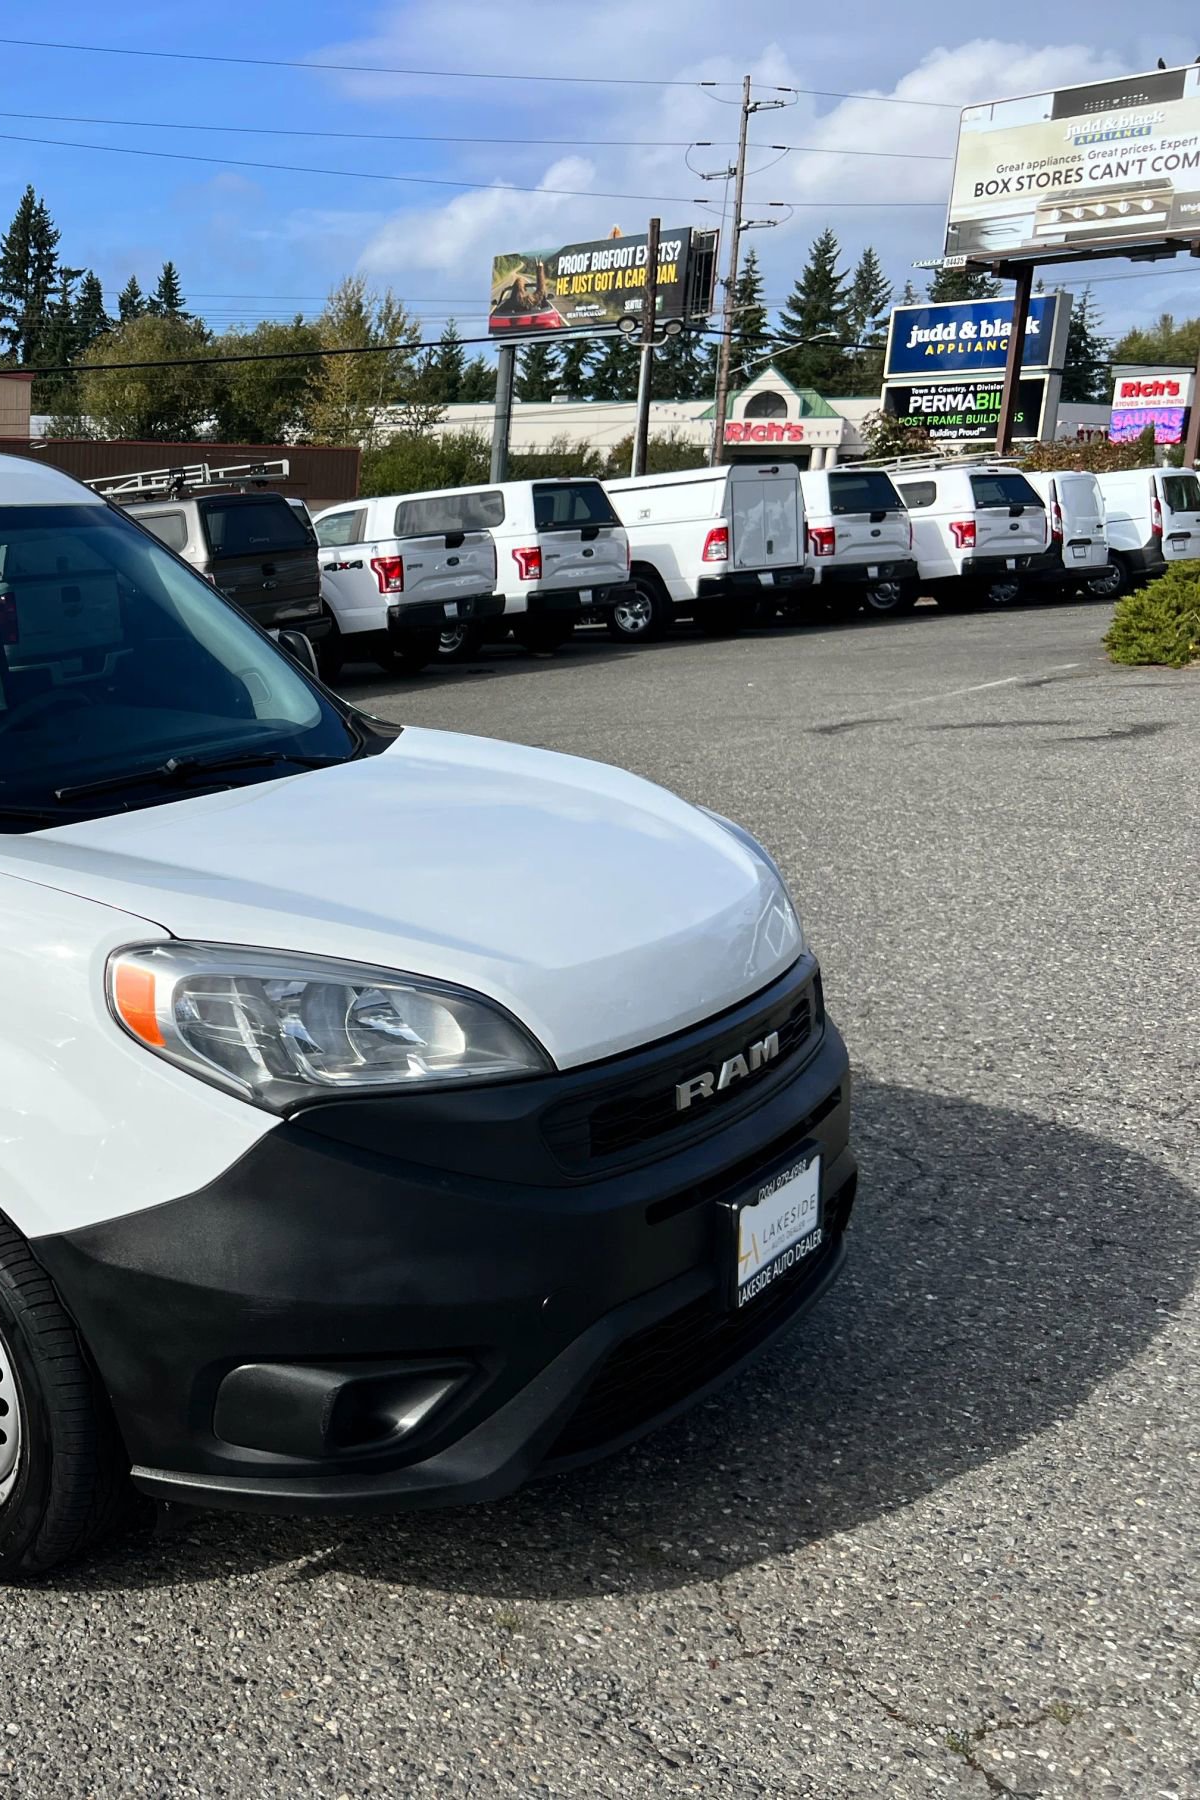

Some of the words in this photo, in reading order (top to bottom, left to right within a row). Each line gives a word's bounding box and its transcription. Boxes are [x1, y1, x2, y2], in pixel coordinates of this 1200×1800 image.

[1064, 119, 1102, 141] judd
[1118, 110, 1166, 129] black
[1076, 127, 1150, 145] APPLIANCE
[996, 161, 1025, 174] Great
[1026, 152, 1085, 173] appliances.
[1087, 148, 1118, 161] Great
[1120, 143, 1157, 160] prices.
[1160, 137, 1198, 151] Expert
[973, 178, 1012, 198] BOX
[1015, 167, 1084, 192] STORES
[1088, 157, 1148, 182] CAN'T
[557, 256, 590, 276] PROOF
[591, 247, 635, 271] BIGFOOT
[556, 277, 569, 296] HE
[570, 272, 592, 294] JUST
[594, 270, 615, 292] GOT
[615, 269, 623, 289] A
[625, 267, 647, 288] CAR
[906, 321, 957, 348] judd
[959, 320, 978, 339] &
[980, 316, 1040, 338] blak
[925, 339, 1009, 355] APPLIANC
[908, 391, 1002, 414] PERMABIL
[911, 387, 929, 395] Town
[930, 386, 936, 394] &
[938, 385, 967, 394] Country,
[1120, 380, 1180, 398] Rich's
[724, 422, 804, 442] Rich's
[898, 416, 925, 427] POST
[926, 414, 963, 426] FRAME
[929, 428, 958, 439] Building
[676, 1031, 779, 1111] RAM
[762, 1193, 816, 1244] LAKESIDE
[738, 1265, 772, 1308] LAKESIDE
[772, 1249, 794, 1280] AUTO
[795, 1228, 822, 1261] DEALER
